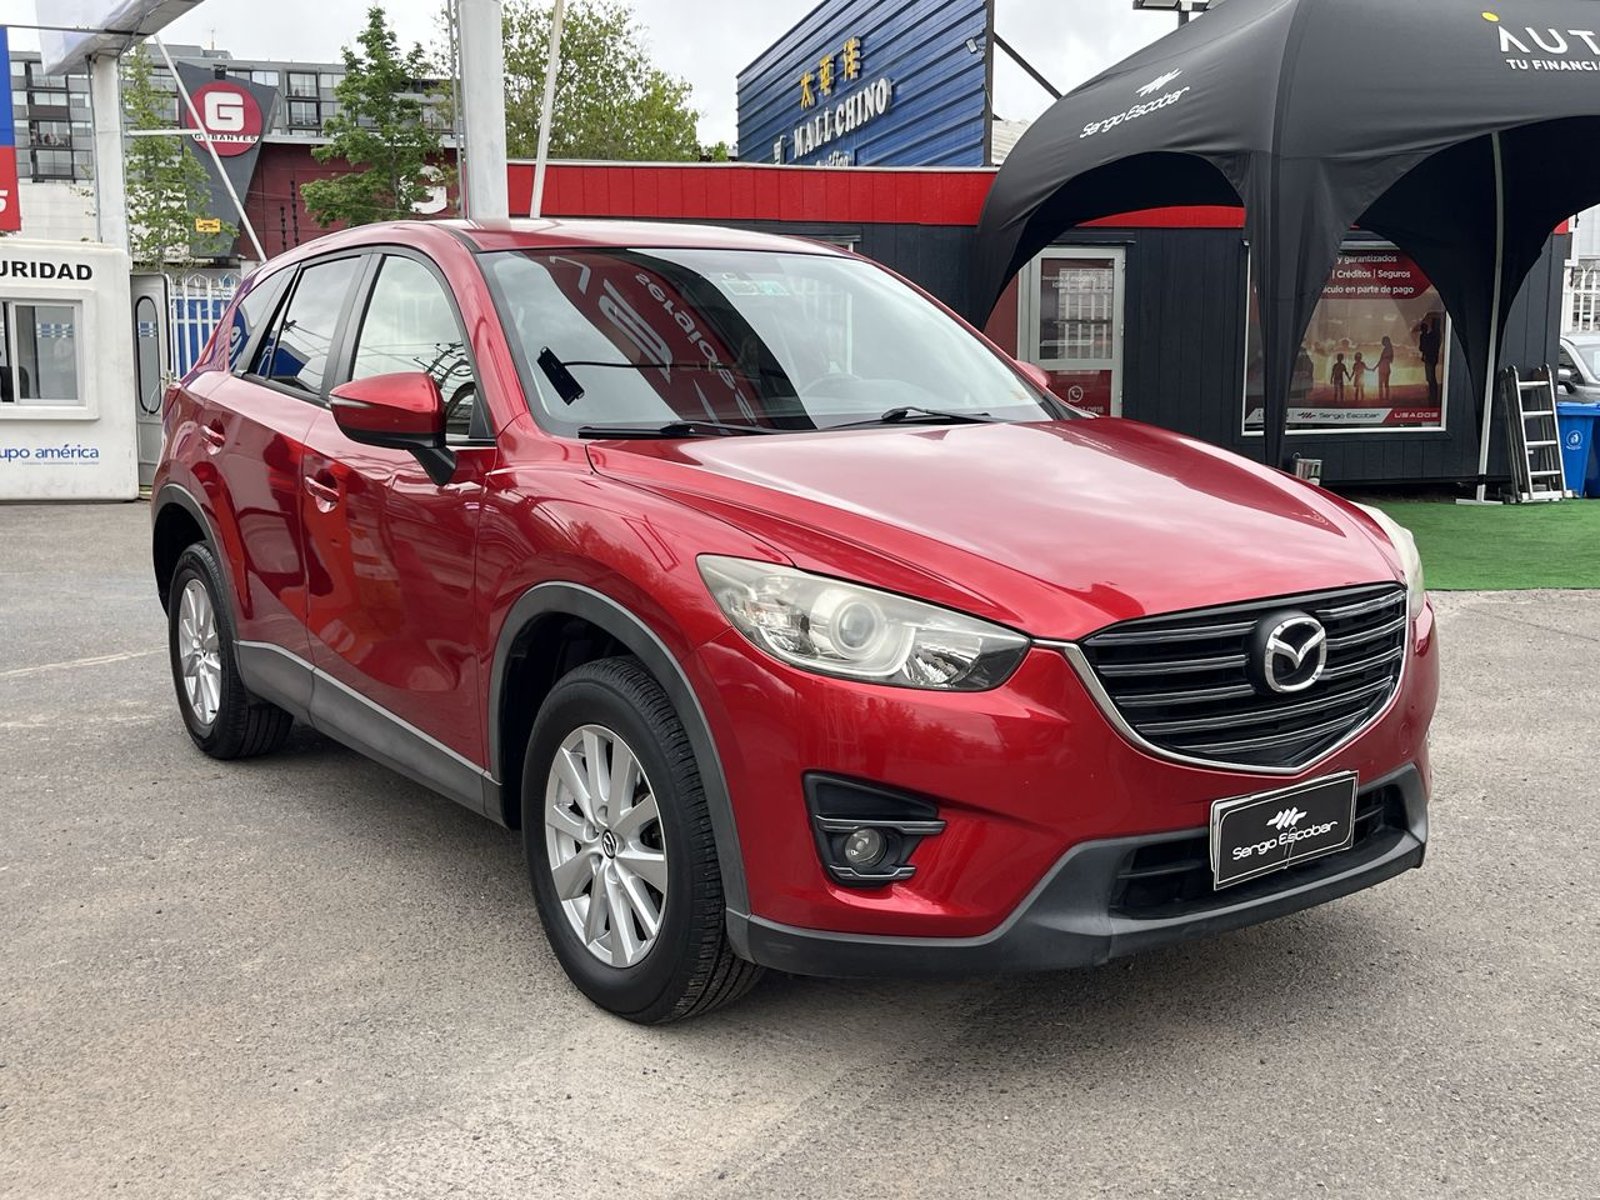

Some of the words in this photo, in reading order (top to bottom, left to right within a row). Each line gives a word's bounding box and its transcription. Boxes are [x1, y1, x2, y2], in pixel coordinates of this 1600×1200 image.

[1506, 59, 1529, 70] TU
[1531, 59, 1600, 71] FINANCI
[1124, 86, 1191, 121] Escobar
[204, 91, 245, 131] G
[793, 109, 835, 159] MALL
[834, 77, 893, 138] CHINO
[194, 133, 256, 142] GBANTES
[1344, 254, 1397, 264] garantizados
[1336, 269, 1371, 279] Créditos
[1377, 269, 1411, 279] Seguros
[1357, 286, 1379, 295] parte
[1380, 285, 1391, 293] de
[1392, 286, 1415, 295] pago
[35, 444, 99, 459] américa
[1278, 821, 1338, 845] Escobar
